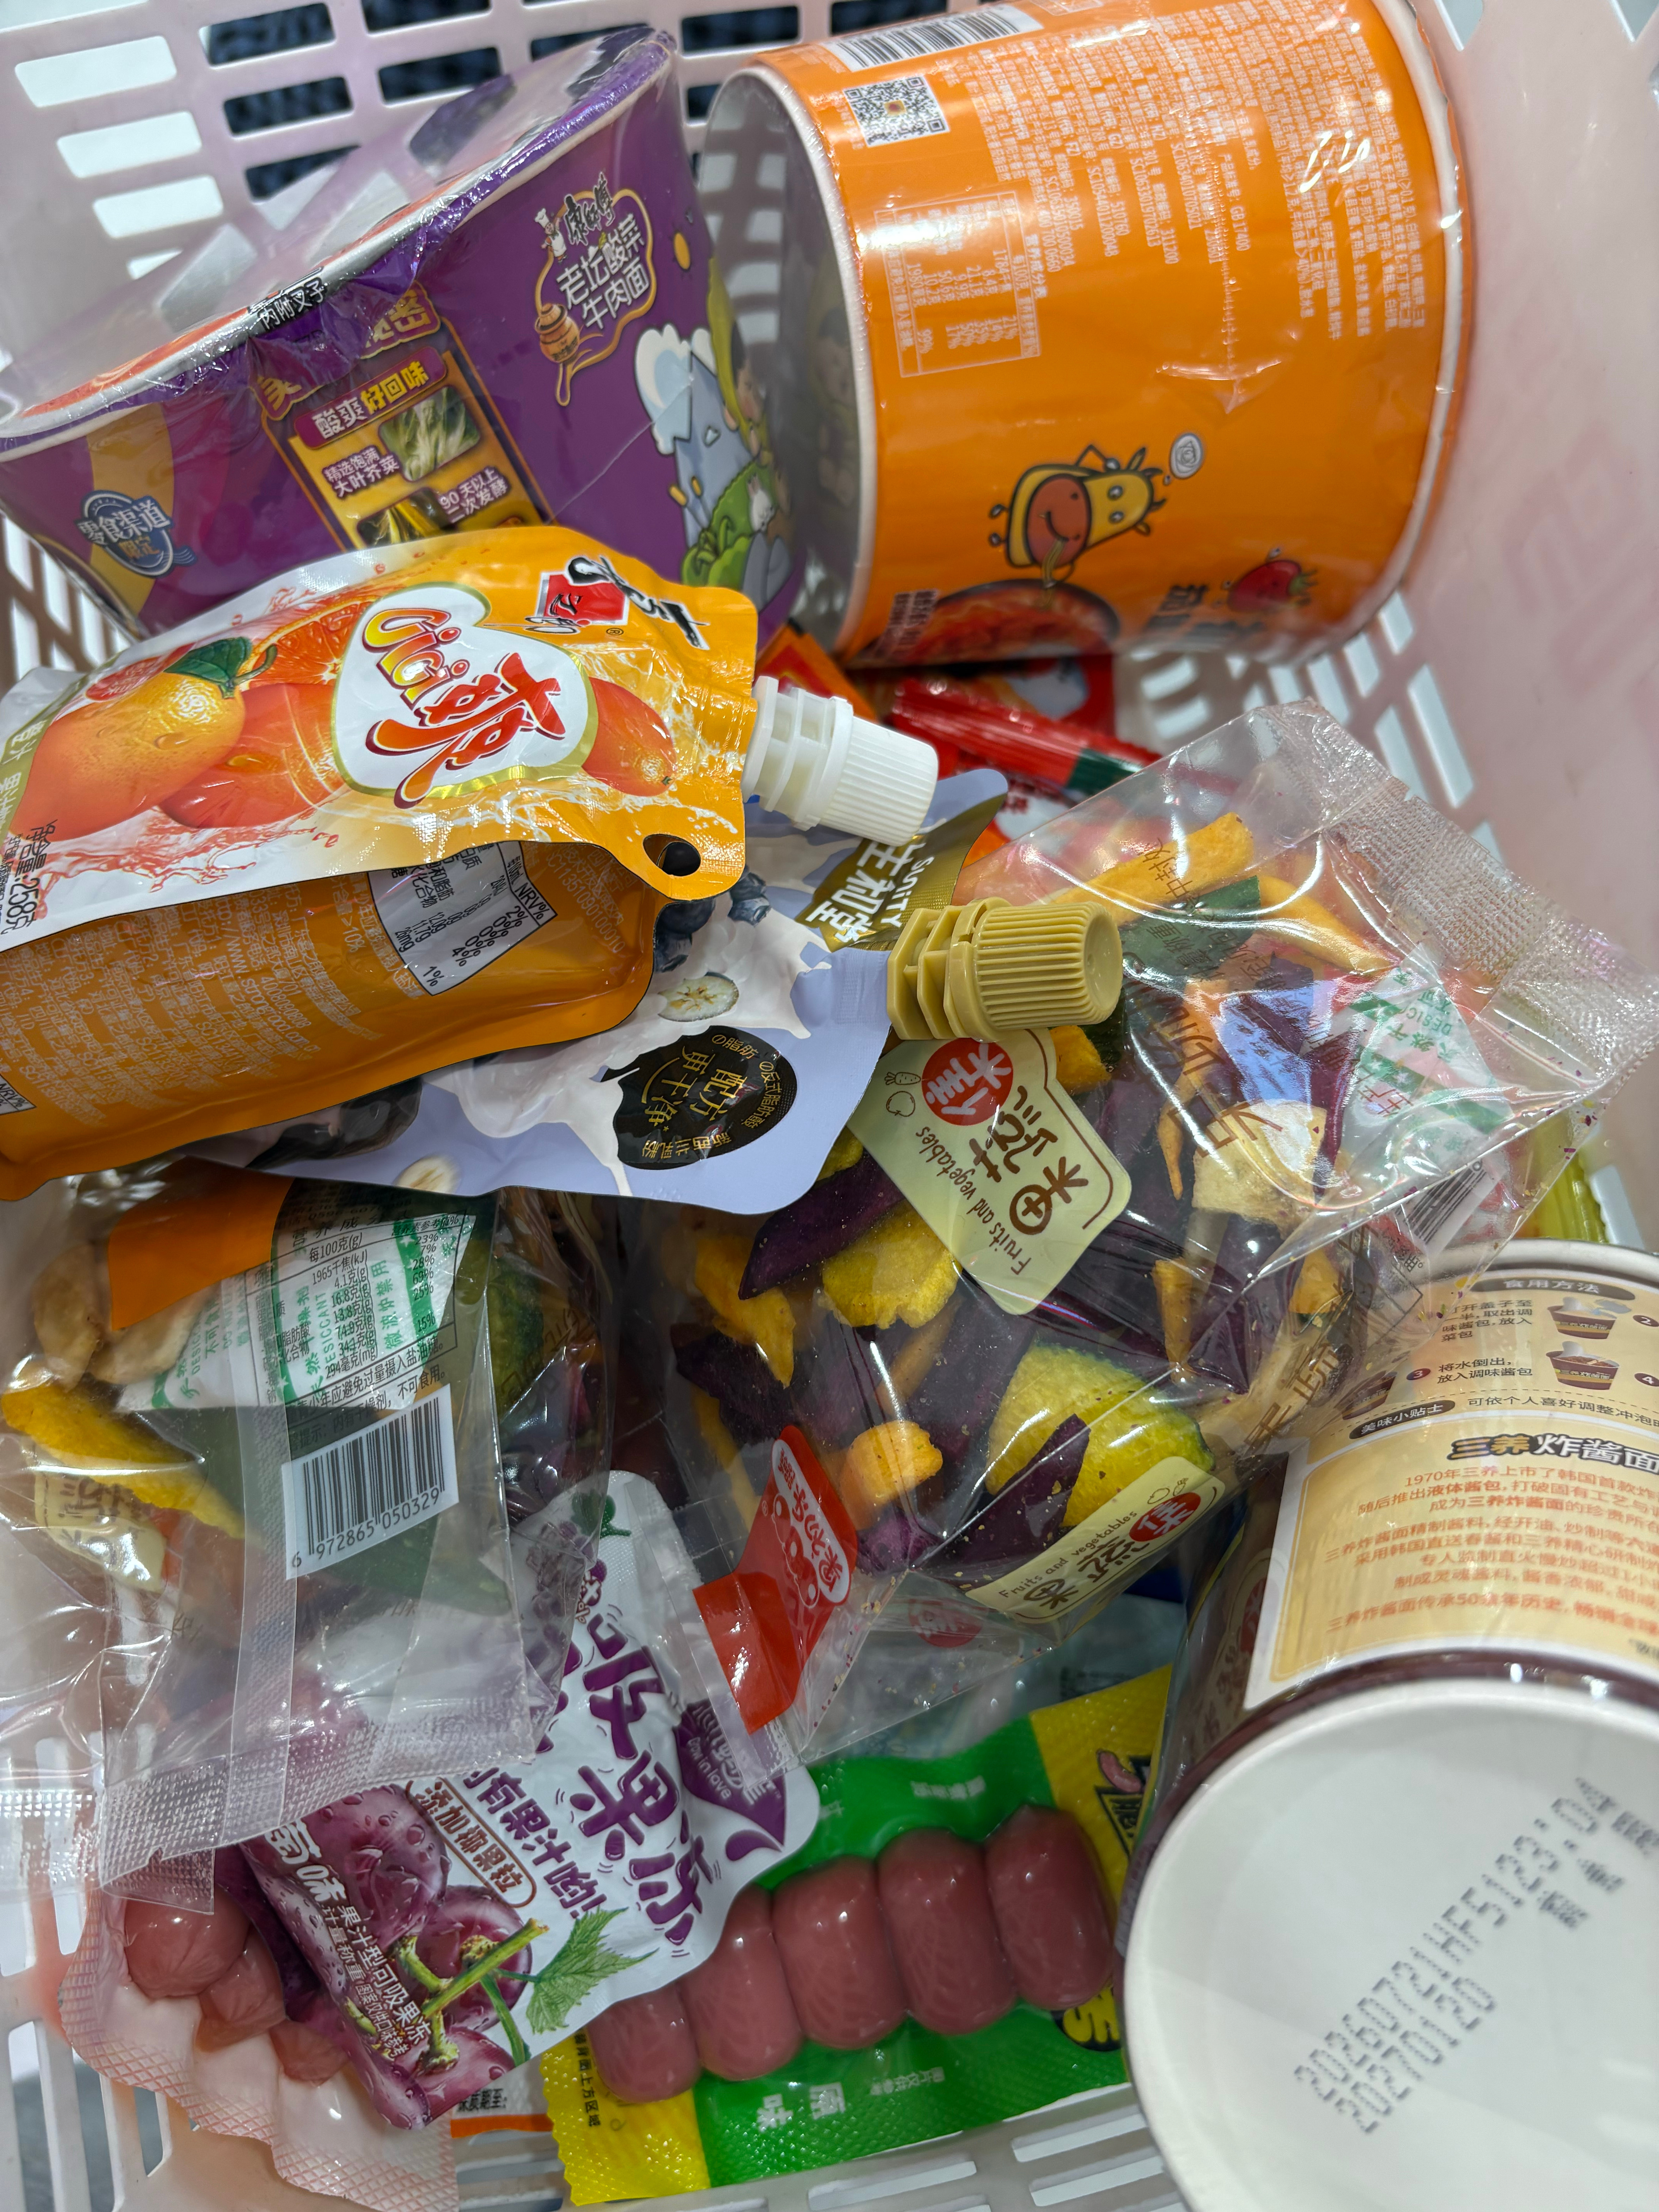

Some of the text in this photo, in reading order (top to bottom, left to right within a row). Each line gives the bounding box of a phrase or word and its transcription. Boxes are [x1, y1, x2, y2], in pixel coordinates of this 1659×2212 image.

[1042, 118, 1057, 131] 13
[1065, 197, 1084, 229] 350015
[1091, 125, 1106, 143] 788
[1109, 201, 1130, 237] 510760
[1167, 142, 1205, 230] SC10634010705021
[564, 172, 615, 246] 康师傅
[1044, 175, 1075, 266] SC10635010500034
[1087, 167, 1119, 257] SC10544011200048
[1129, 157, 1161, 248] SC10633019702613
[1142, 148, 1159, 166] 301
[1160, 227, 1179, 265] 311200
[1229, 204, 1246, 221] GB
[556, 213, 644, 310] 老坛酸菜
[1042, 229, 1055, 247] 700
[1046, 249, 1061, 272] 0660
[1230, 220, 1252, 252] 17400
[582, 256, 650, 330] 牛肉面
[922, 272, 941, 306] 10.2克
[965, 264, 985, 299] 21.1克
[1012, 254, 1030, 290] 每100克
[1024, 234, 1048, 300] 营养成分表
[257, 278, 326, 330] 内附叉子
[905, 262, 935, 354] 1980毫克 99%
[936, 270, 962, 349] 50.6克 17%
[952, 273, 977, 347] 9.9克 50%
[981, 268, 1005, 342] 8.4克 14%
[992, 249, 1020, 340] 1784千焦 21%
[312, 361, 429, 440] 酸爽好回味
[324, 447, 380, 481] 精选饱满
[334, 457, 399, 498] 大叶芥菜
[79, 500, 171, 544] 零食渠道
[448, 482, 508, 522] 二次发酵
[118, 536, 160, 560] 限定
[365, 653, 567, 809] 爽
[487, 874, 529, 929] 204kJ 2%
[514, 881, 550, 922] NRV%
[808, 836, 926, 944] 生和堂
[408, 919, 434, 945] 11.7g
[424, 910, 474, 969] 12.0g 4%
[445, 909, 487, 958] 0g 0%
[477, 924, 501, 948] 0%
[491, 914, 515, 939] 0%
[390, 925, 445, 988] 26mg 1%
[642, 1046, 718, 1129] 更干净
[689, 1066, 749, 1124] 配方
[915, 1125, 1032, 1276] Fruits and vegetables
[307, 1232, 365, 1263] 每100克(g)
[311, 1231, 439, 1285] 1965千焦(kJ) 23%
[411, 1254, 436, 1269] 28%
[419, 1242, 438, 1255] 7%
[410, 1267, 435, 1284] 69%
[411, 1283, 436, 1302] 25%
[1503, 1278, 1601, 1295] 食用方法
[322, 1312, 438, 1379] 294毫克(mg) 15%
[1441, 1331, 1474, 1343] 菜包
[1442, 1317, 1532, 1334] 味酱包，放入
[1414, 1358, 1512, 1379] 3 将水倒出，
[1437, 1367, 1533, 1384] 放入调味酱包
[1360, 1403, 1444, 1434] 美味小贴士
[1449, 1434, 1659, 1475] 三养炸酱面
[1405, 1465, 1659, 1499] 1970年三养上市了韩国首款炸
[291, 1487, 440, 1568] 6 972865 050329
[998, 1510, 1138, 1599] Fruits and vegetables
[696, 1756, 714, 1774] in
[706, 1767, 737, 1800] love
[414, 1778, 526, 1896] 添加椰果粒
[321, 1905, 367, 1982] 计量称重
[338, 1905, 429, 2043] 果汁型可吸果冻
[355, 1983, 411, 2061] 图案仅供口味参考
[1335, 1977, 1496, 2134] 20270120
